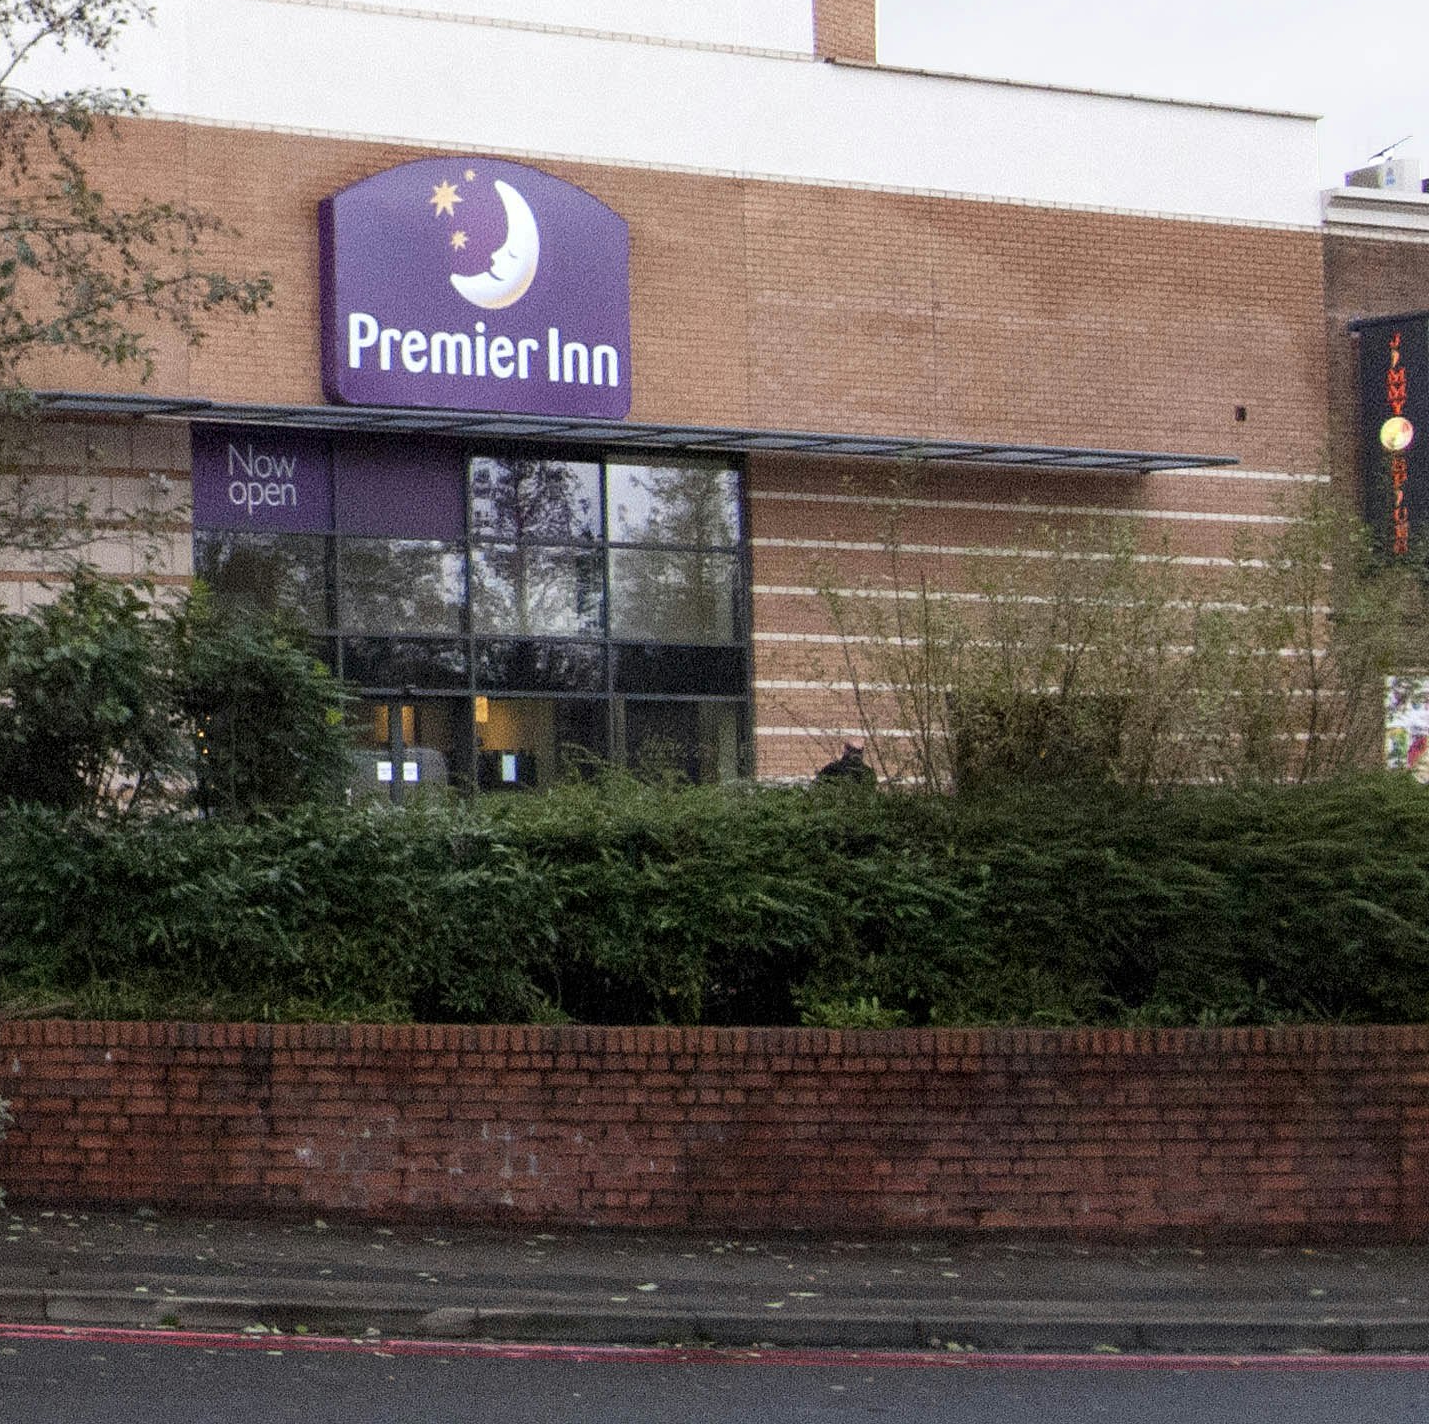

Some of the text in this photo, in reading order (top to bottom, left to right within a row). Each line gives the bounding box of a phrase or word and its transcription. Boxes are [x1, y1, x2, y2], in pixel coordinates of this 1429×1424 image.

[348, 312, 618, 387] Premier Inn
[229, 443, 297, 478] Now
[229, 481, 297, 516] open
